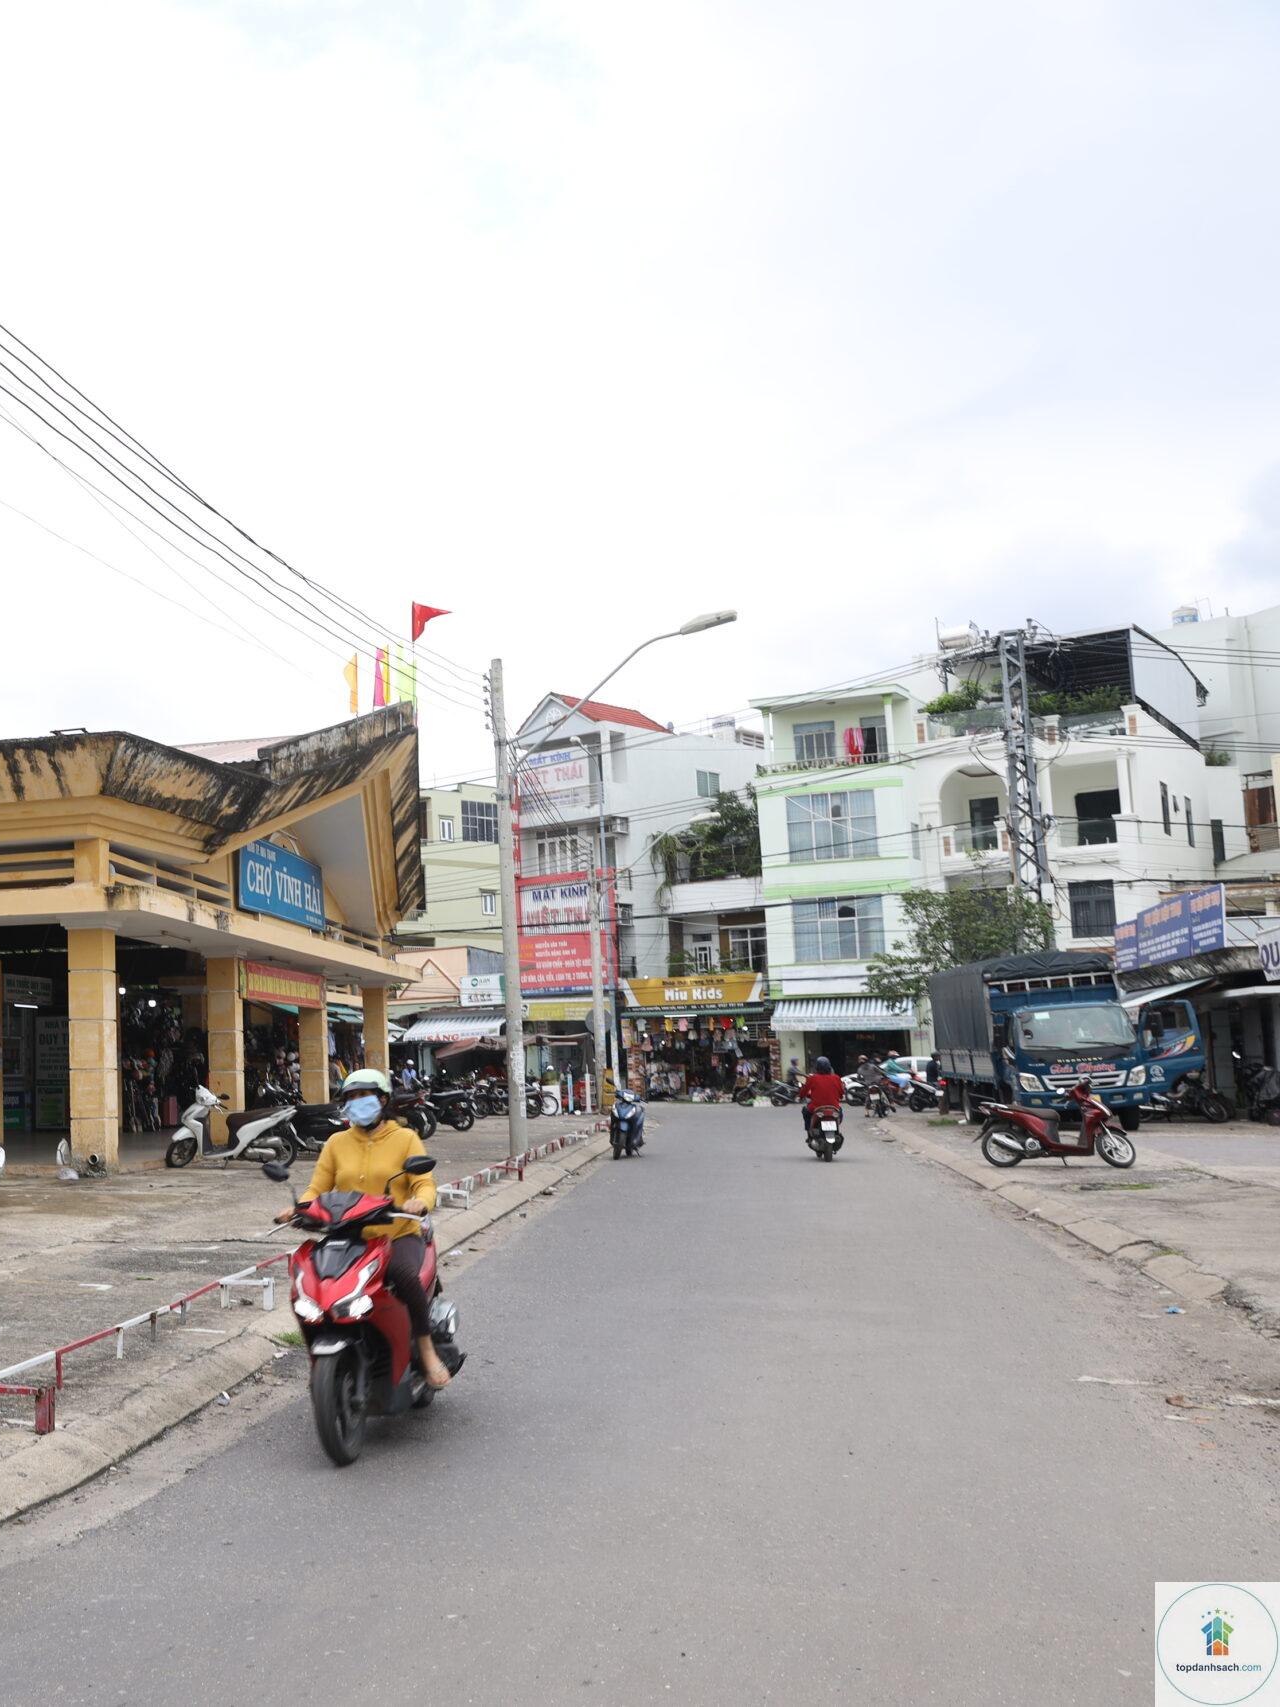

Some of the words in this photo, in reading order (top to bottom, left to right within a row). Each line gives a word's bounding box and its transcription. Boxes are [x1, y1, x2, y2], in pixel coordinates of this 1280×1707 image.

[246, 859, 273, 905] CHỢ
[275, 866, 303, 909] VĨNH
[303, 875, 322, 916] HẢI
[692, 986, 723, 1001] Kids
